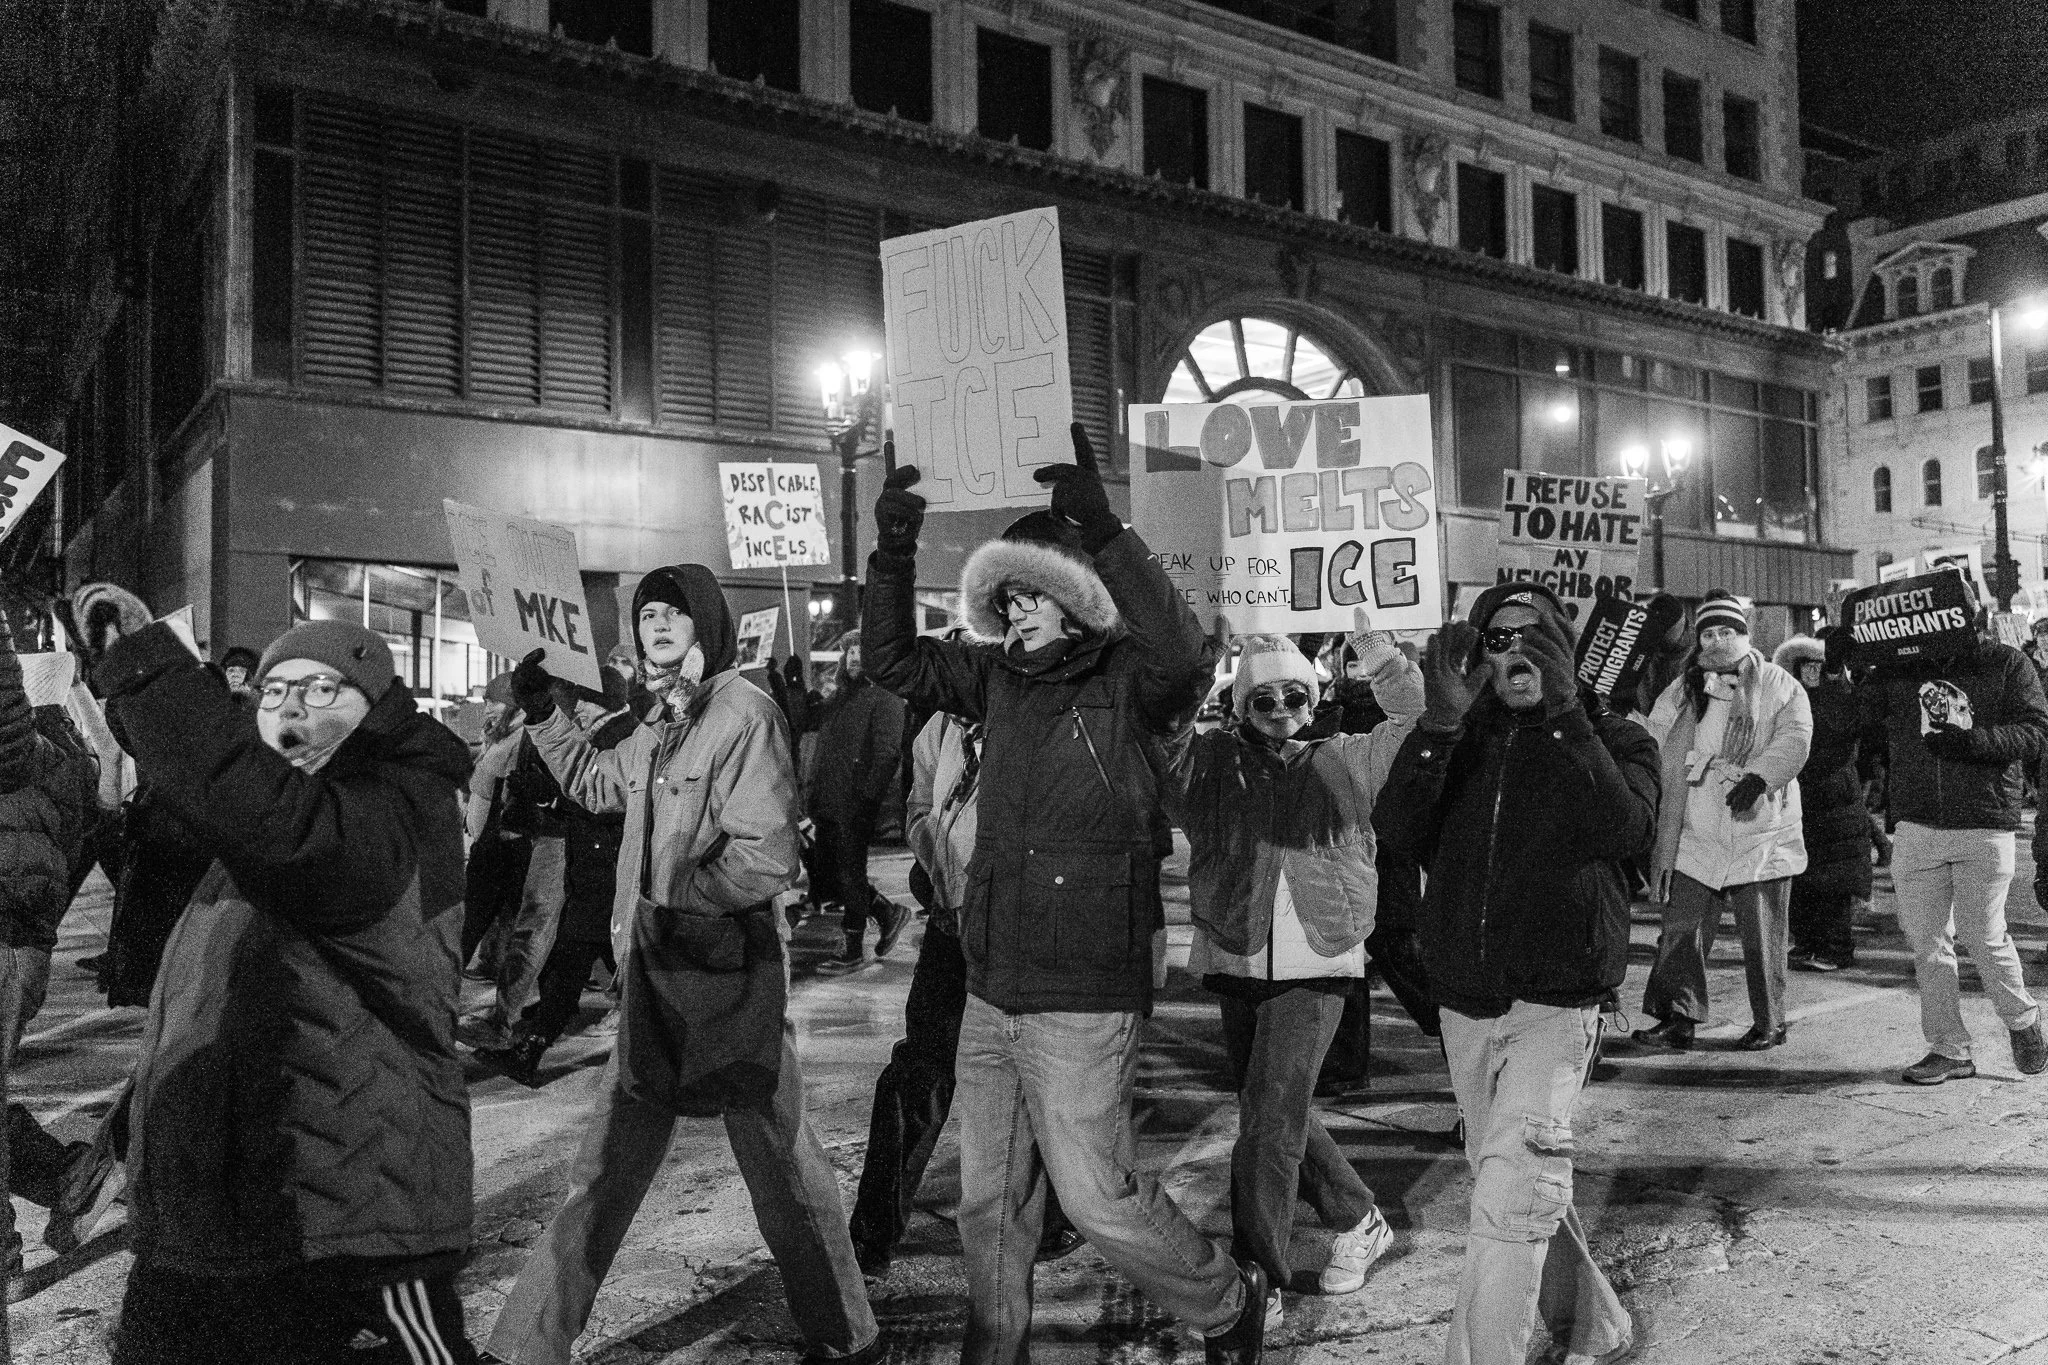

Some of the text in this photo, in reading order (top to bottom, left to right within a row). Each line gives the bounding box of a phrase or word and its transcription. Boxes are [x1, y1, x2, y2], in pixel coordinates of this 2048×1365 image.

[887, 216, 1059, 376] FUCK
[897, 352, 1055, 504] ICE
[1145, 402, 1361, 473] LOVE
[731, 468, 815, 496] DESPICABLE
[1226, 461, 1431, 538] MELTS
[1506, 475, 1628, 509] I REFUSE
[1505, 504, 1640, 545] TO HATE
[1153, 553, 1281, 576] EAK UP FOR
[1290, 537, 1420, 611] ICE
[1553, 548, 1588, 570] MY
[513, 588, 588, 655] MKE
[1206, 590, 1241, 605] WHO
[1245, 586, 1291, 605] CAN'T.
[1854, 587, 1934, 622] PROTECT
[1578, 617, 1619, 685] PROTECT
[1851, 607, 1966, 643] MMIGRANTS
[1593, 609, 1648, 696] MMIGRANTS
